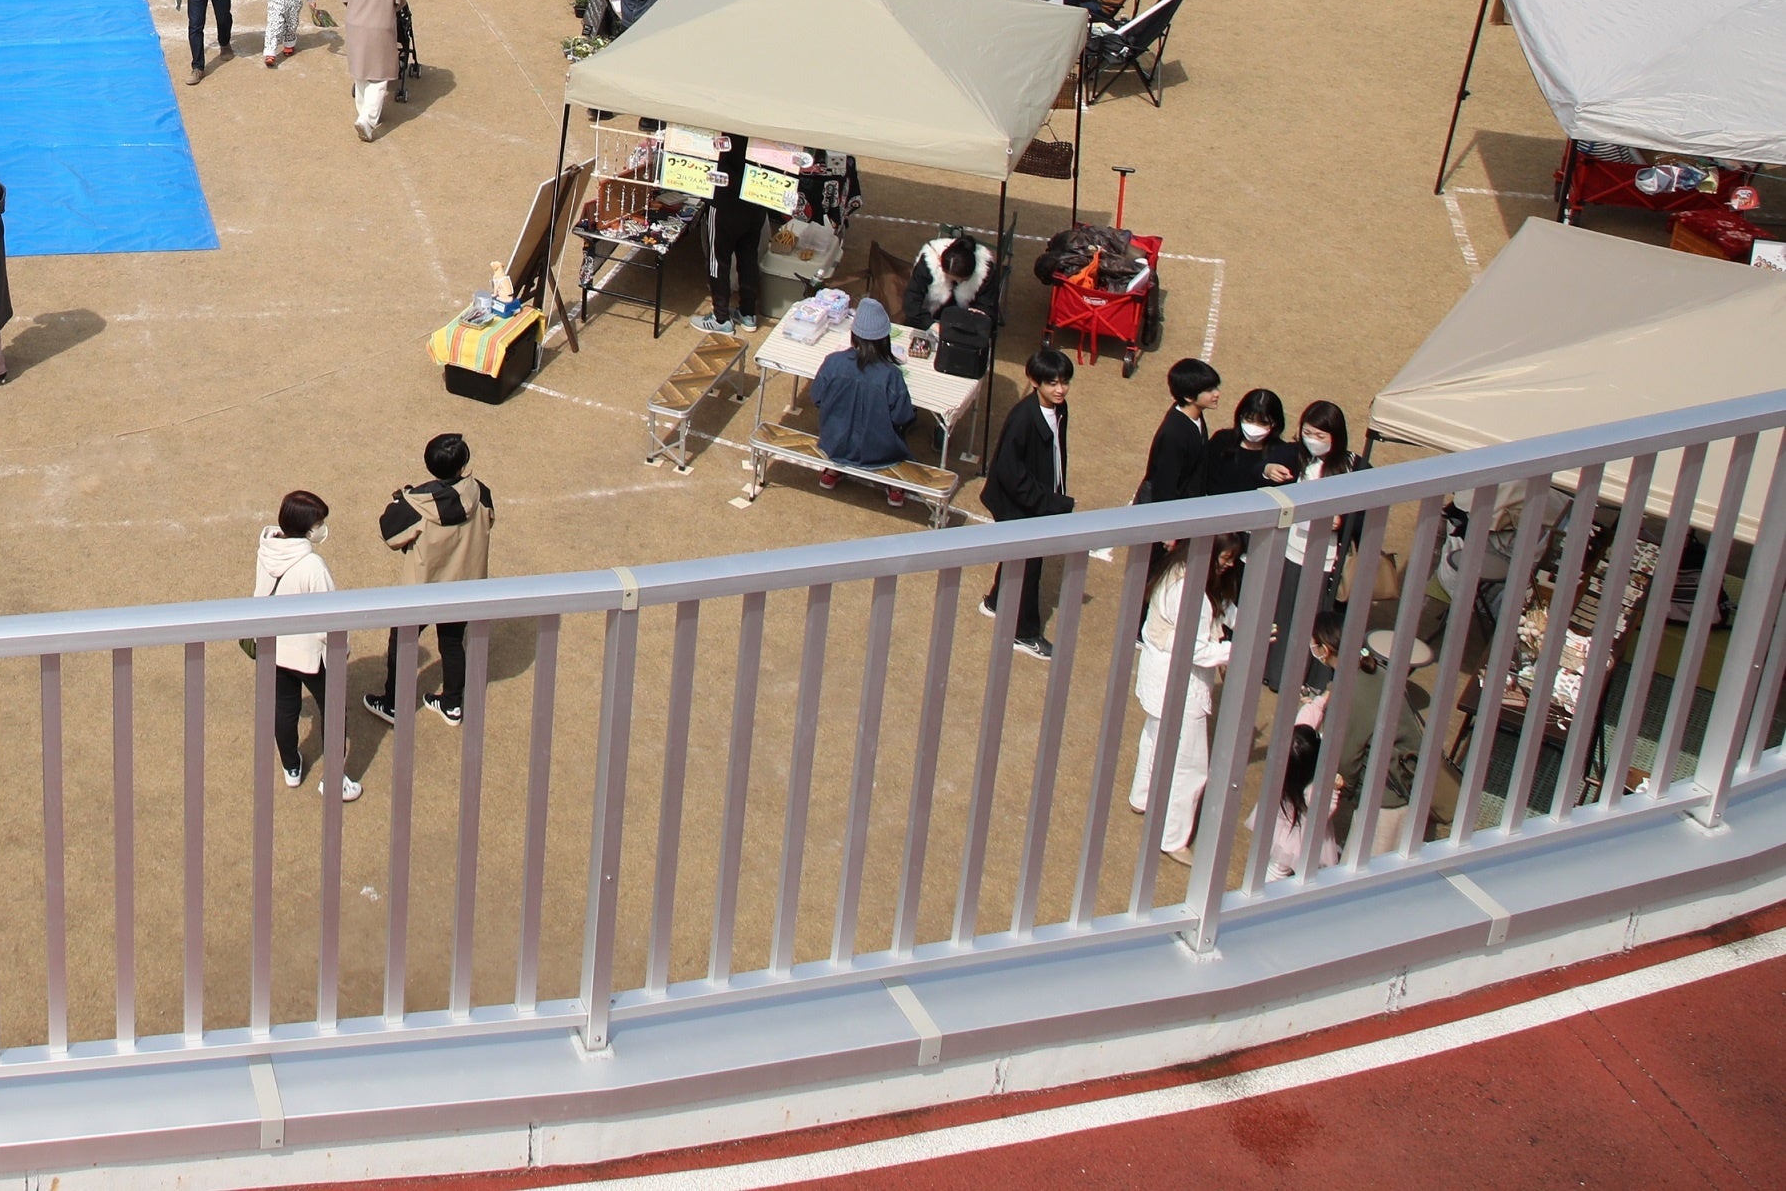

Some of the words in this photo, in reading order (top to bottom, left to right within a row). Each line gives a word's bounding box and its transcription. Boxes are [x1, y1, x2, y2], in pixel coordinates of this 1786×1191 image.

[667, 157, 714, 173] ワークショップ
[749, 169, 796, 188] ワークショップ
